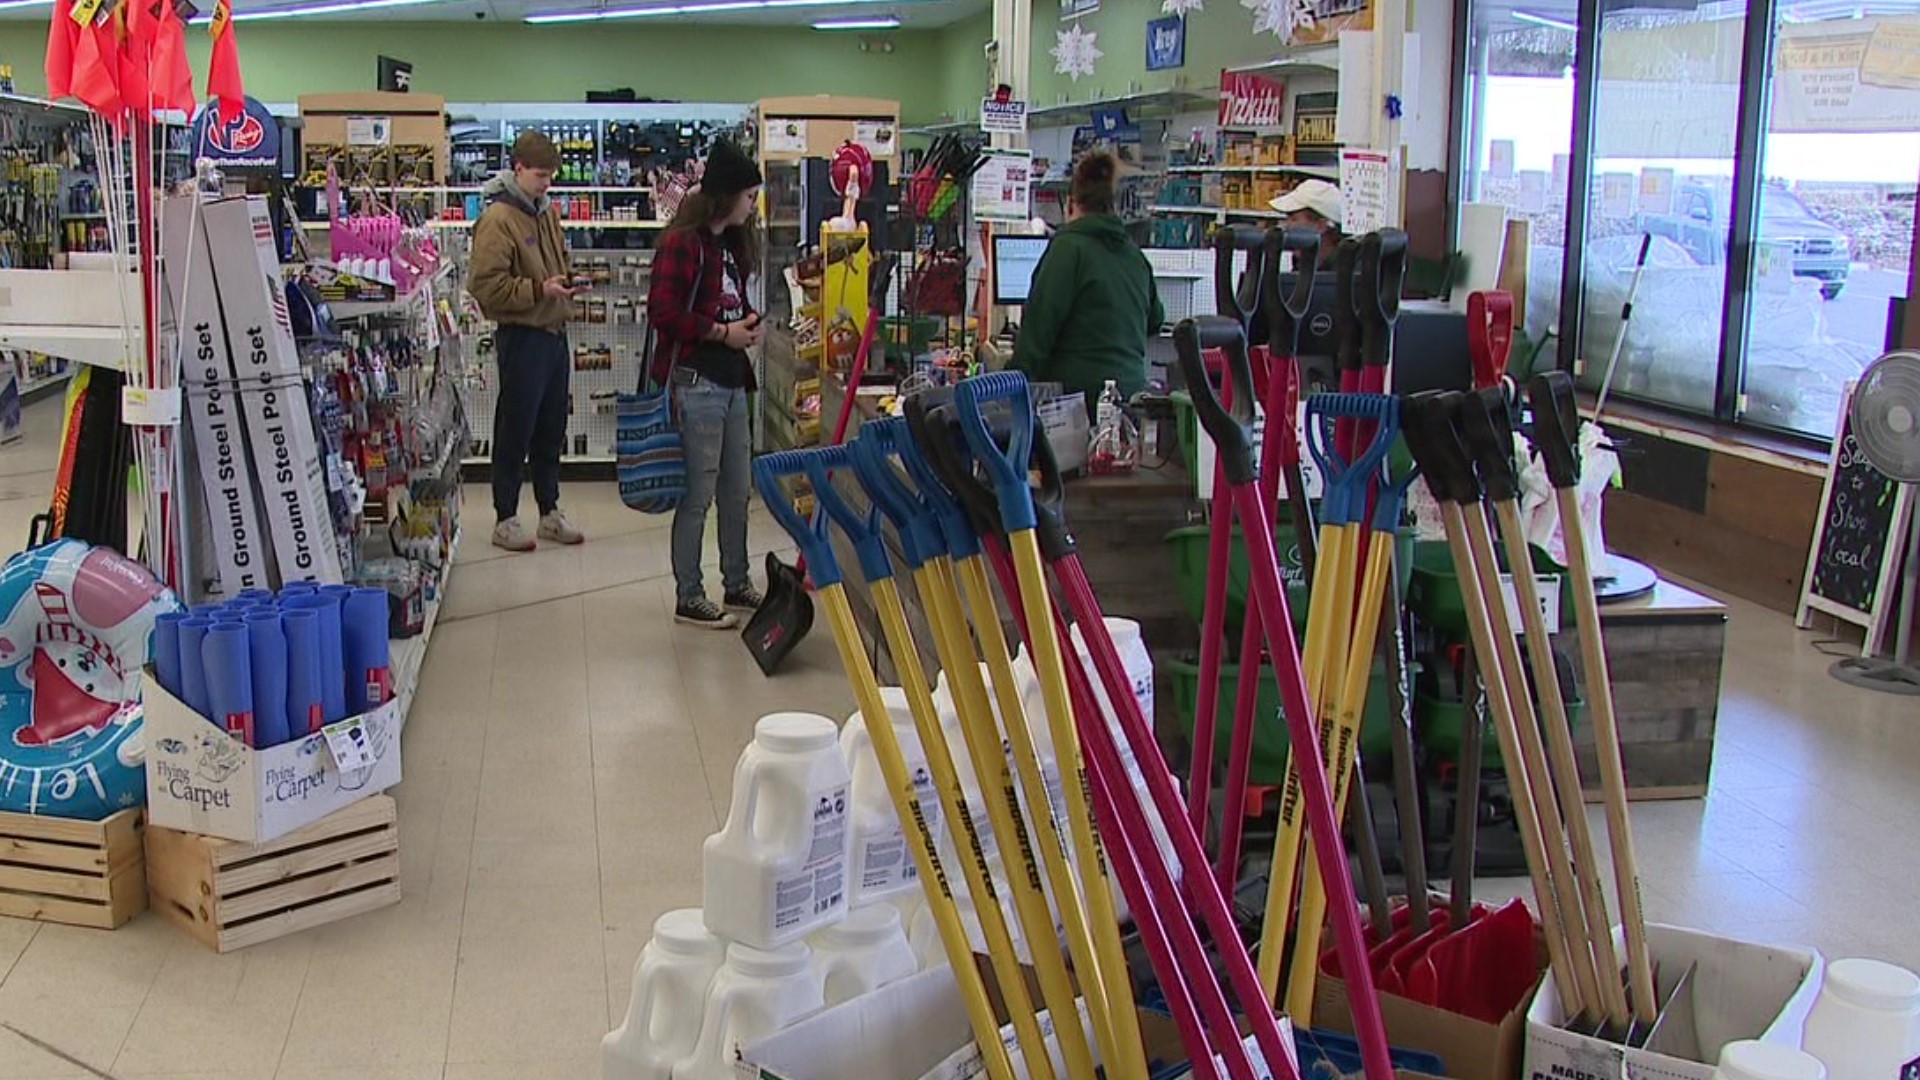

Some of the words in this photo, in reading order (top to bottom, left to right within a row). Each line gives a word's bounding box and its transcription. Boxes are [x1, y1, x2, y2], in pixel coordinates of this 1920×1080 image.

[195, 322, 214, 361] Set
[247, 326, 268, 365] Set
[203, 368, 225, 417] Pole
[258, 371, 280, 420] Pole
[209, 423, 235, 481] Steel
[266, 426, 294, 484] Steel
[222, 487, 250, 568] Ground
[281, 489, 313, 569] Ground
[1820, 536, 1872, 571] Local
[156, 760, 190, 785] Flying
[265, 766, 297, 787] Flying
[275, 766, 327, 802] Carpet
[168, 778, 231, 811] Carpet
